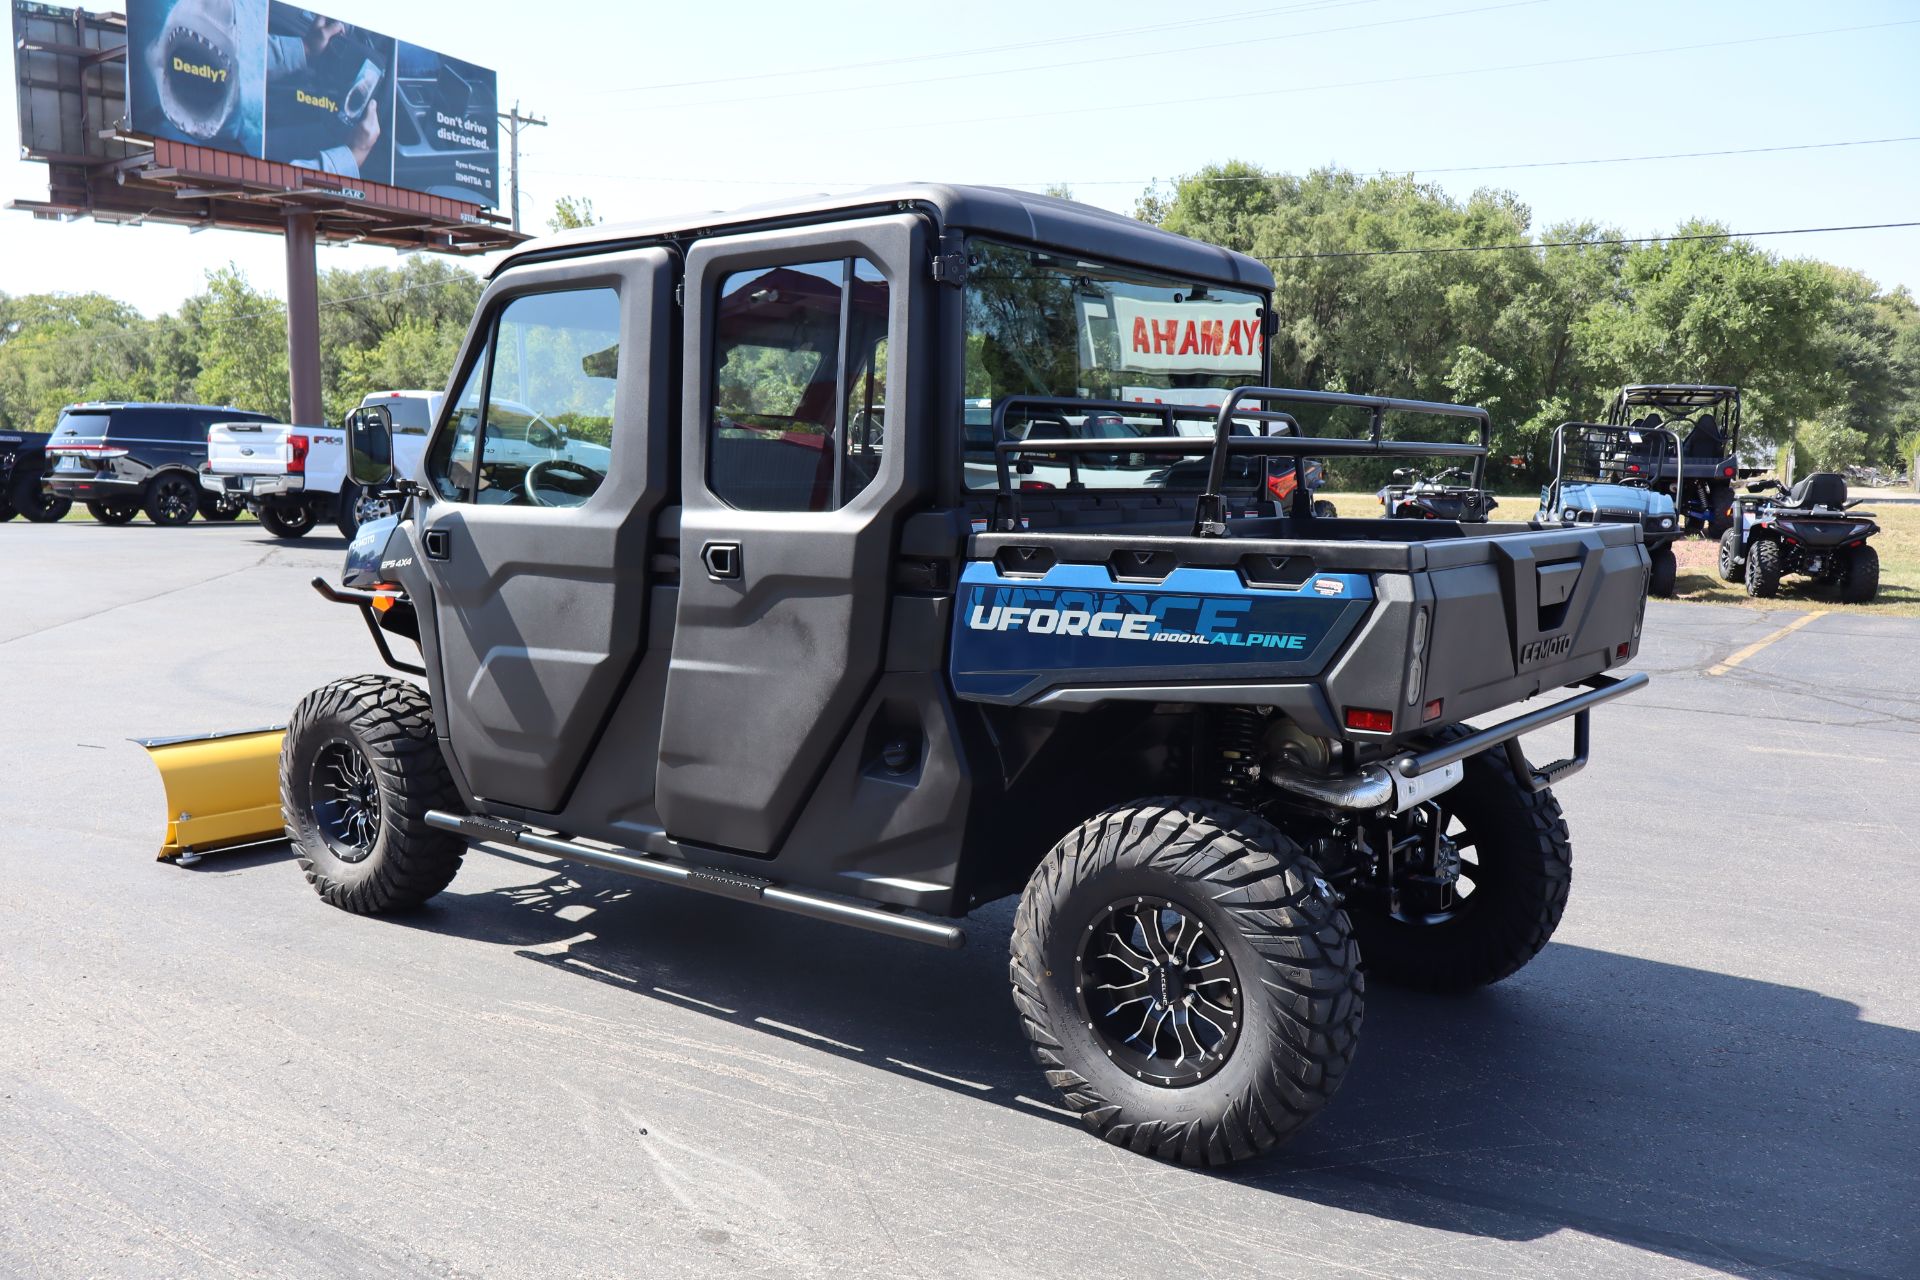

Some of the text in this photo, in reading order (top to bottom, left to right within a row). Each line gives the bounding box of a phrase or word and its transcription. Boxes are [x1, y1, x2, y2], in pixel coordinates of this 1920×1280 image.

[173, 56, 227, 83] Deadly?
[296, 89, 339, 112] Deadly.
[436, 111, 488, 135] Don't drive
[437, 127, 490, 150] distracted.
[381, 560, 397, 569] EPS
[970, 605, 1307, 650] UFORCE 1000XL ALPINE
[1520, 634, 1571, 664] CFMOTO
